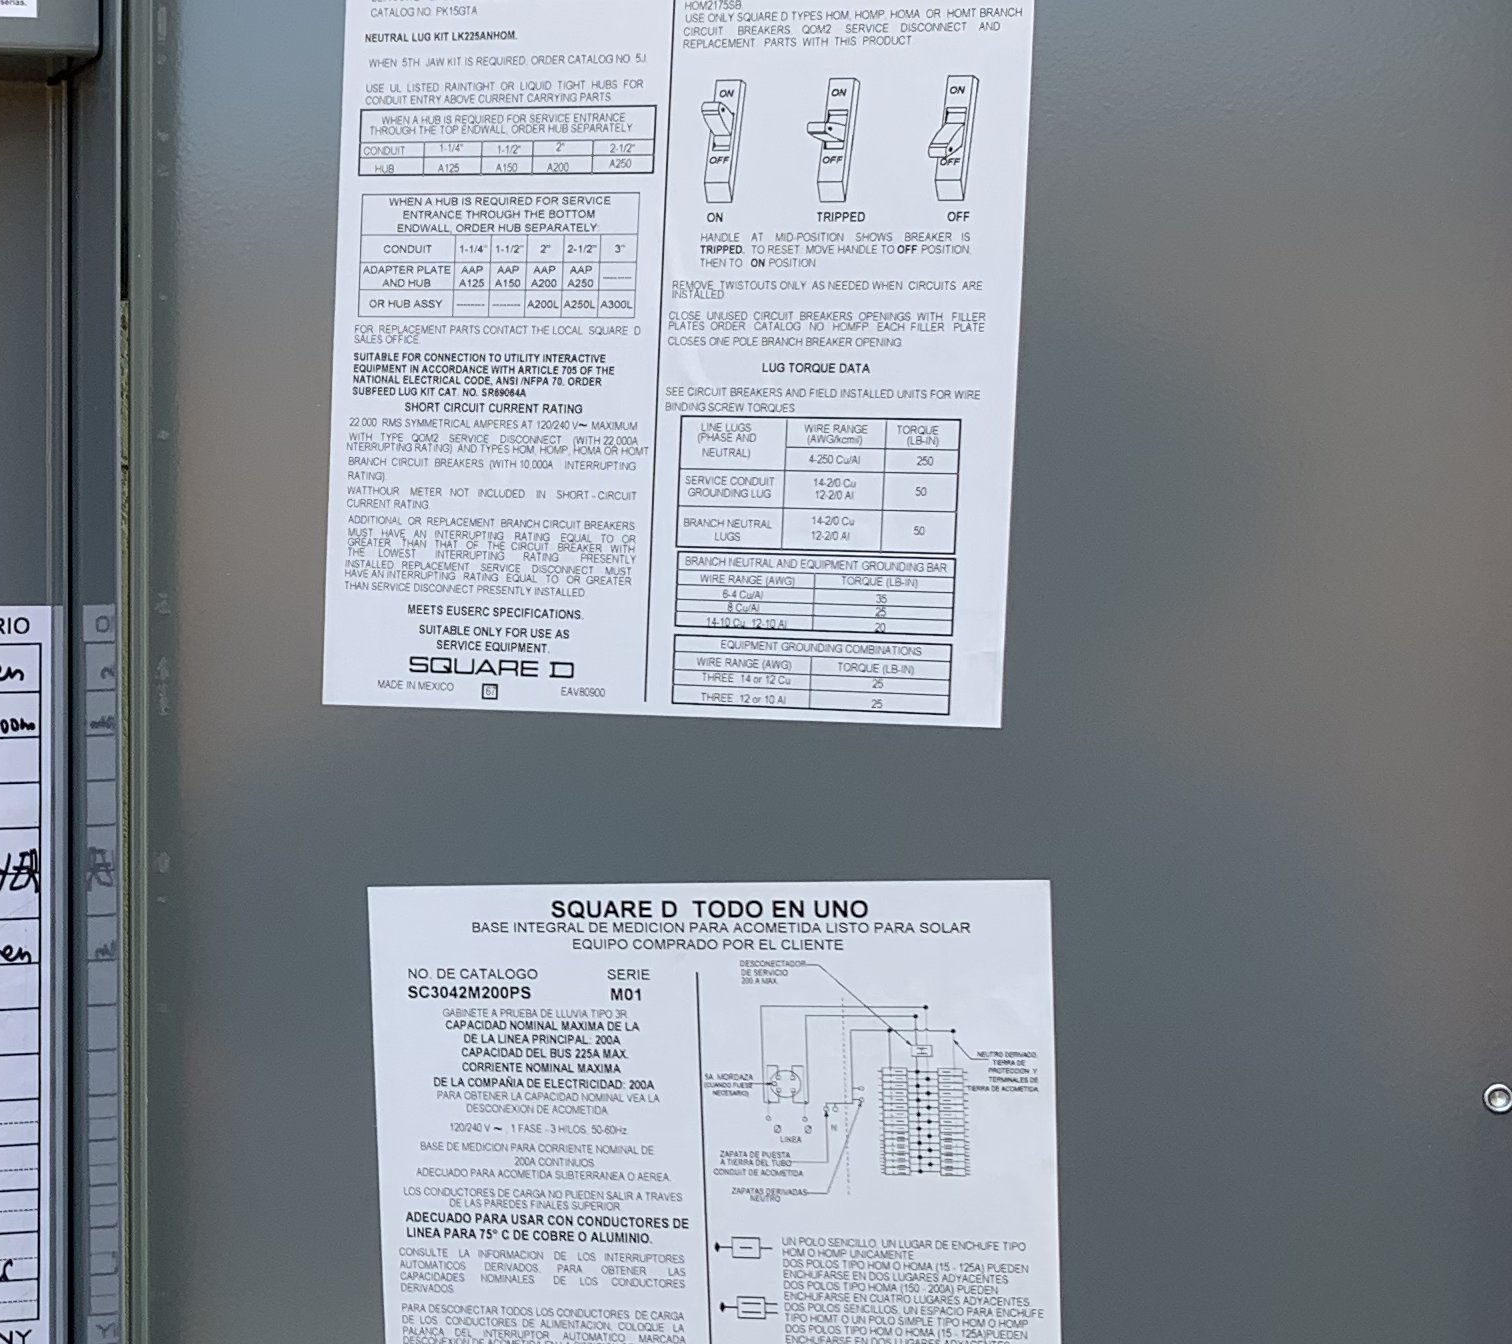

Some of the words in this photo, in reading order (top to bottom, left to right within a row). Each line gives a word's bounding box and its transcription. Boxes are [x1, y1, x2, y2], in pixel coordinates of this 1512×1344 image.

[706, 212, 723, 223] ON
[816, 211, 866, 223] TRIPPED
[947, 211, 970, 222] OFF
[761, 362, 786, 373] LUG
[788, 362, 836, 374] TORQUE
[839, 362, 871, 374] DATA
[408, 655, 539, 678] SQUARE
[549, 661, 575, 679] D
[551, 900, 653, 920] SQUARE
[661, 900, 677, 918] D
[692, 900, 763, 919] TODO
[772, 900, 805, 919] EN
[814, 899, 868, 919] UNO
[436, 968, 456, 980] DE
[459, 968, 538, 980] CATALOGO
[607, 968, 651, 981] SERIE
[408, 985, 532, 1000] SC3042M200PS
[610, 987, 641, 1001] M01
